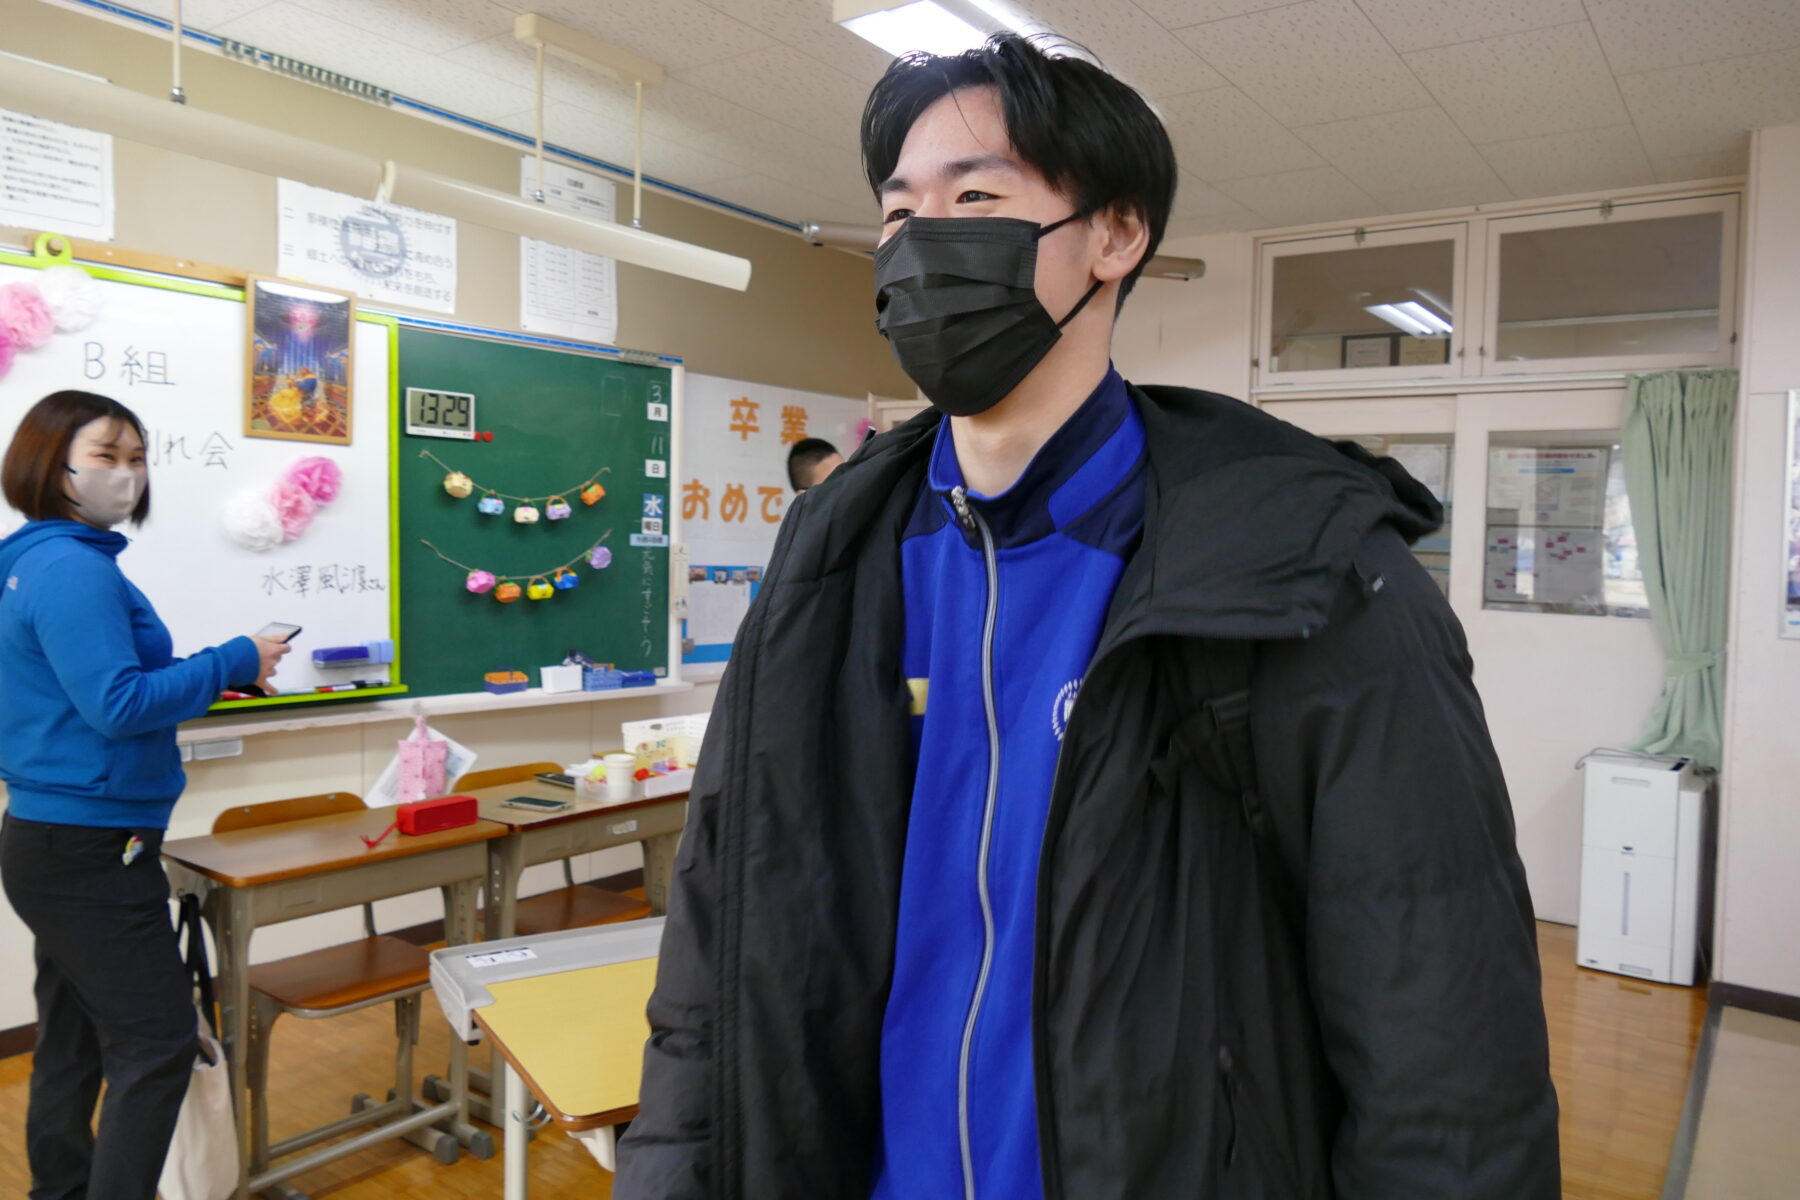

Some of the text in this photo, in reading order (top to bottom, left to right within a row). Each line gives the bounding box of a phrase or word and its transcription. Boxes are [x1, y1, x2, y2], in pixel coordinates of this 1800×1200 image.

[651, 384, 663, 403] 3
[652, 463, 661, 475] 日
[644, 494, 663, 517] 水
[645, 521, 661, 533] 曜日
